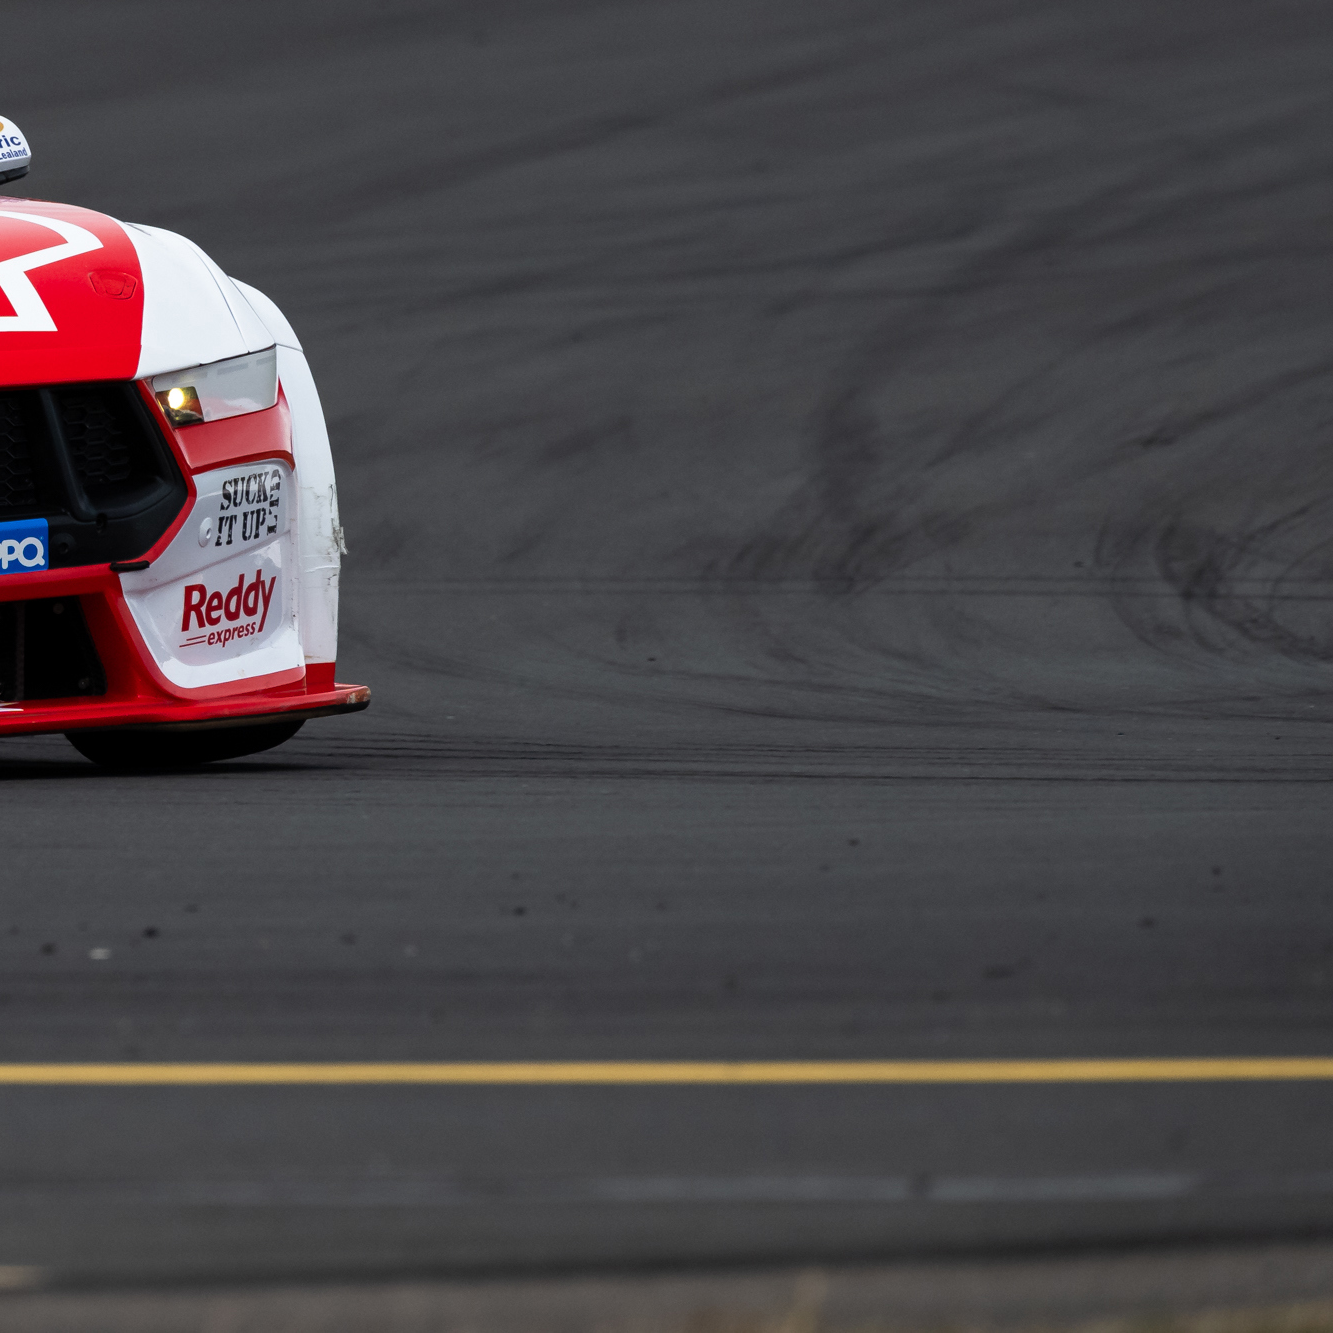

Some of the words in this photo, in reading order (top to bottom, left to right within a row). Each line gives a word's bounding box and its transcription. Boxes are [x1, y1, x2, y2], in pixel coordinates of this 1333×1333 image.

[219, 470, 270, 512] SUCK
[214, 514, 238, 547] IT
[241, 507, 267, 542] UP
[180, 568, 277, 634] Reddy
[206, 621, 257, 648] express
